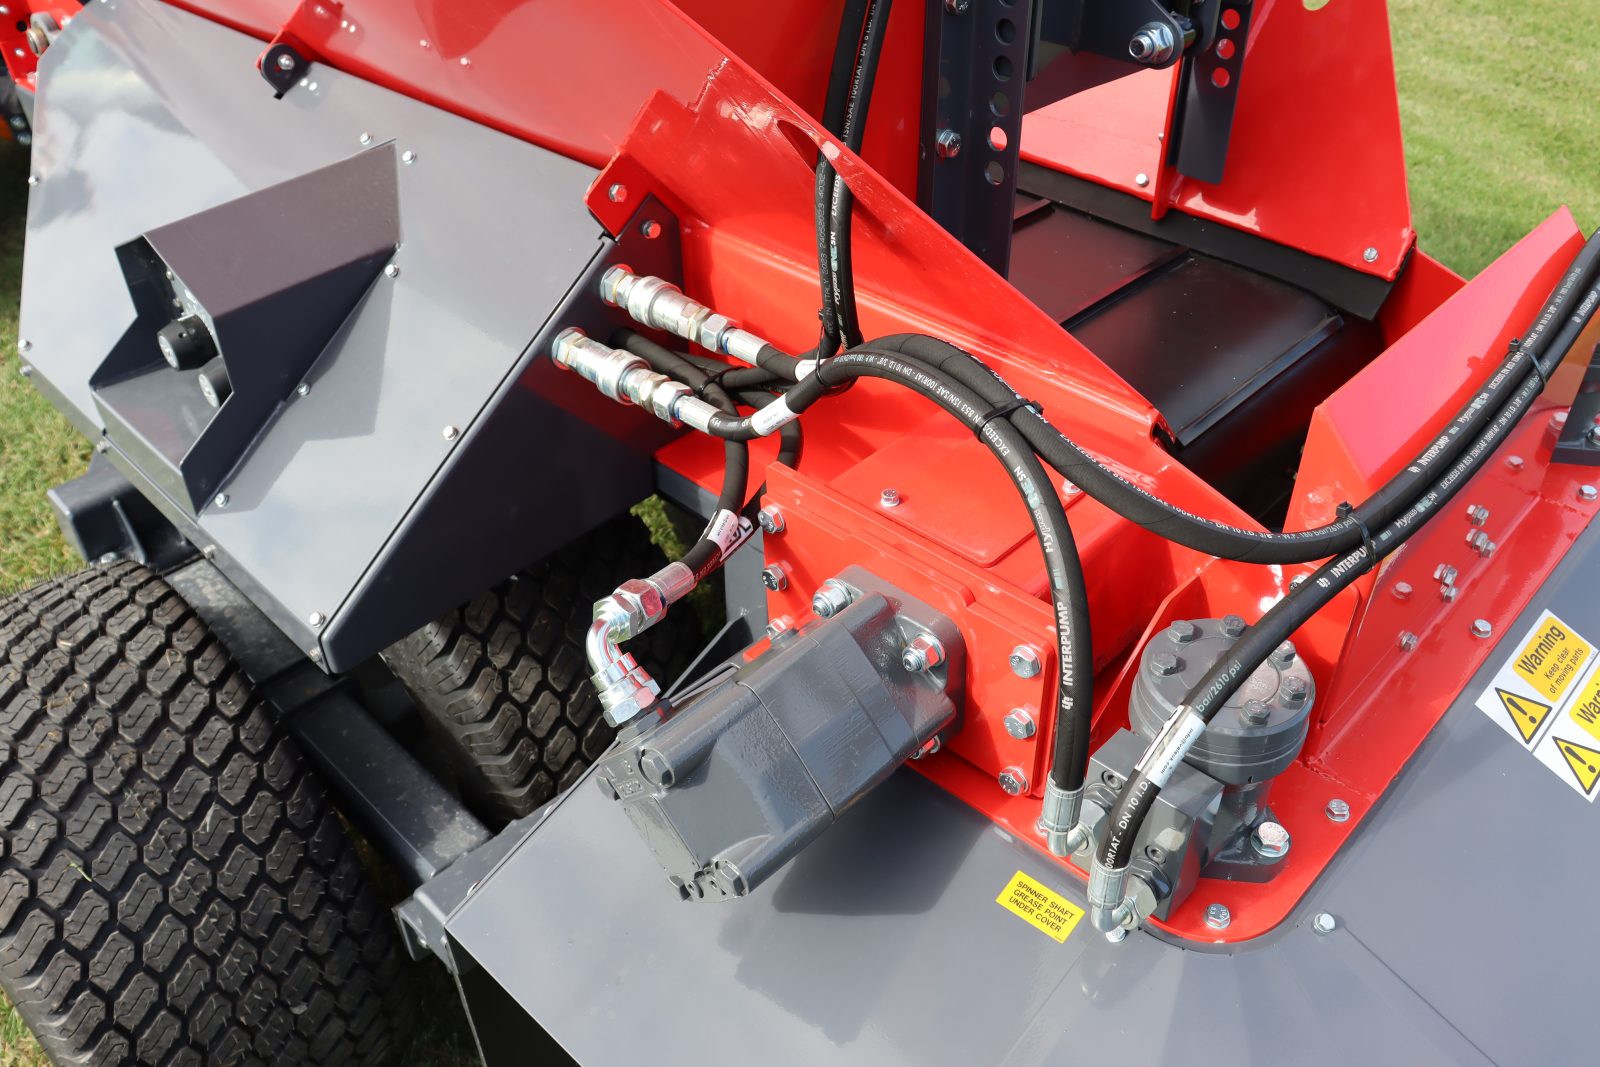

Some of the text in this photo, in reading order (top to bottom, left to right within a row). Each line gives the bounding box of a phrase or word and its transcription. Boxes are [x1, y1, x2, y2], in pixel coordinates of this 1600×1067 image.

[831, 174, 841, 216] EXCEEDS
[903, 366, 912, 376] DN
[914, 372, 938, 391] 100R1AT
[936, 385, 962, 407] 1SN/SAE
[961, 404, 975, 416] 853
[1417, 435, 1450, 466] INTERPUMP
[1488, 373, 1506, 389] EXCEEDS
[982, 423, 1010, 457] EXCEEDS
[1440, 469, 1460, 490] EXCEEDS
[1463, 455, 1473, 466] 853
[1469, 440, 1488, 458] 1SN/SAE
[1056, 601, 1074, 687] INTERPUMP
[1196, 540, 1376, 712] bar/2610 psi INTERPUP
[1517, 625, 1565, 675] Warning
[1543, 647, 1570, 680] Keep clear
[1549, 647, 1584, 694] of moving parts
[1105, 781, 1151, 869] 00R1AT DN 10 I.D.
[1009, 896, 1062, 932] UNDER COVER
[1013, 889, 1067, 925] GREASE POINT
[1016, 881, 1075, 919] SPINNER SHAFT
